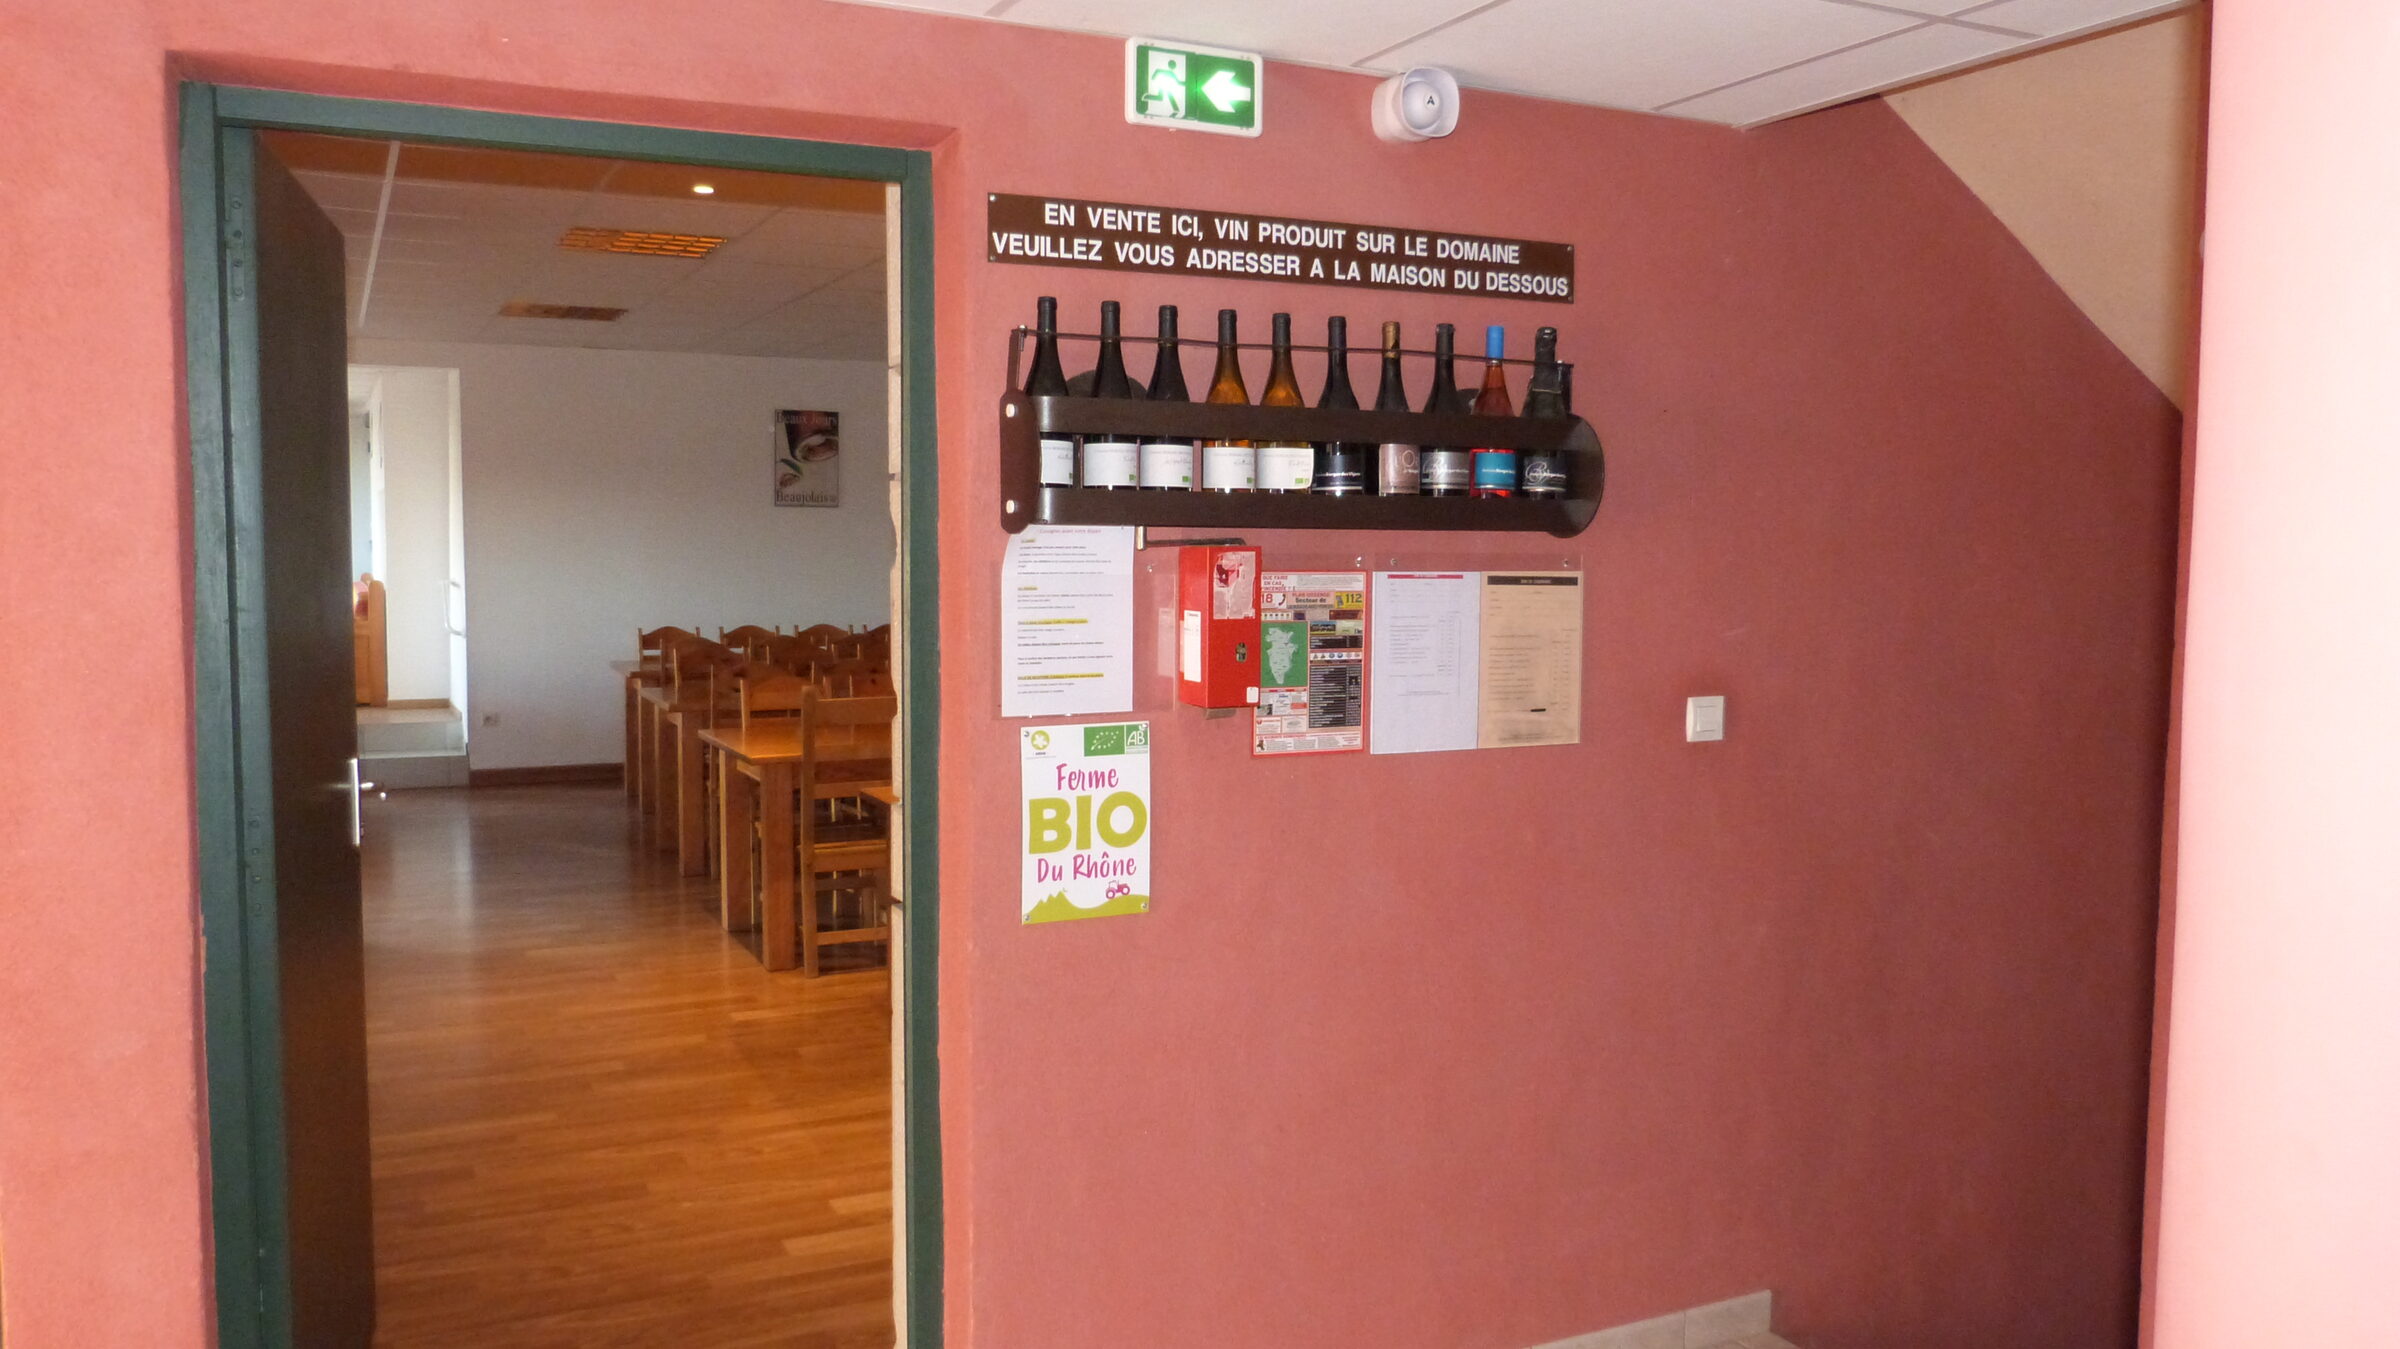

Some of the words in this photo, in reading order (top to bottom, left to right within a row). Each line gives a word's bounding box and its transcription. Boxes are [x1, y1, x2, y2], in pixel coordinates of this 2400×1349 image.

[1044, 202, 1075, 227] EN
[1086, 206, 1161, 234] VENTE
[1171, 214, 1204, 242] ICI,
[1214, 218, 1249, 242] VIN
[1258, 221, 1347, 251] PRODUIT
[1356, 231, 1396, 254] SUR
[1404, 235, 1428, 257] LE
[1436, 238, 1520, 265] DOMAINE
[991, 231, 1103, 262] VEUILLEZ
[1114, 241, 1175, 267] VOUS
[1186, 247, 1301, 276] ADRESSER
[1309, 257, 1325, 279] A
[1334, 259, 1361, 281] LA
[1370, 262, 1446, 288] MAISON
[1454, 269, 1480, 290] DU
[1486, 271, 1568, 296] DESSOUS
[1345, 593, 1363, 603] 112
[1127, 730, 1146, 746] AB
[1055, 763, 1119, 791] Ferme
[1028, 791, 1148, 854] BIO
[1037, 858, 1063, 883] Du
[1073, 851, 1137, 881] Rhône
